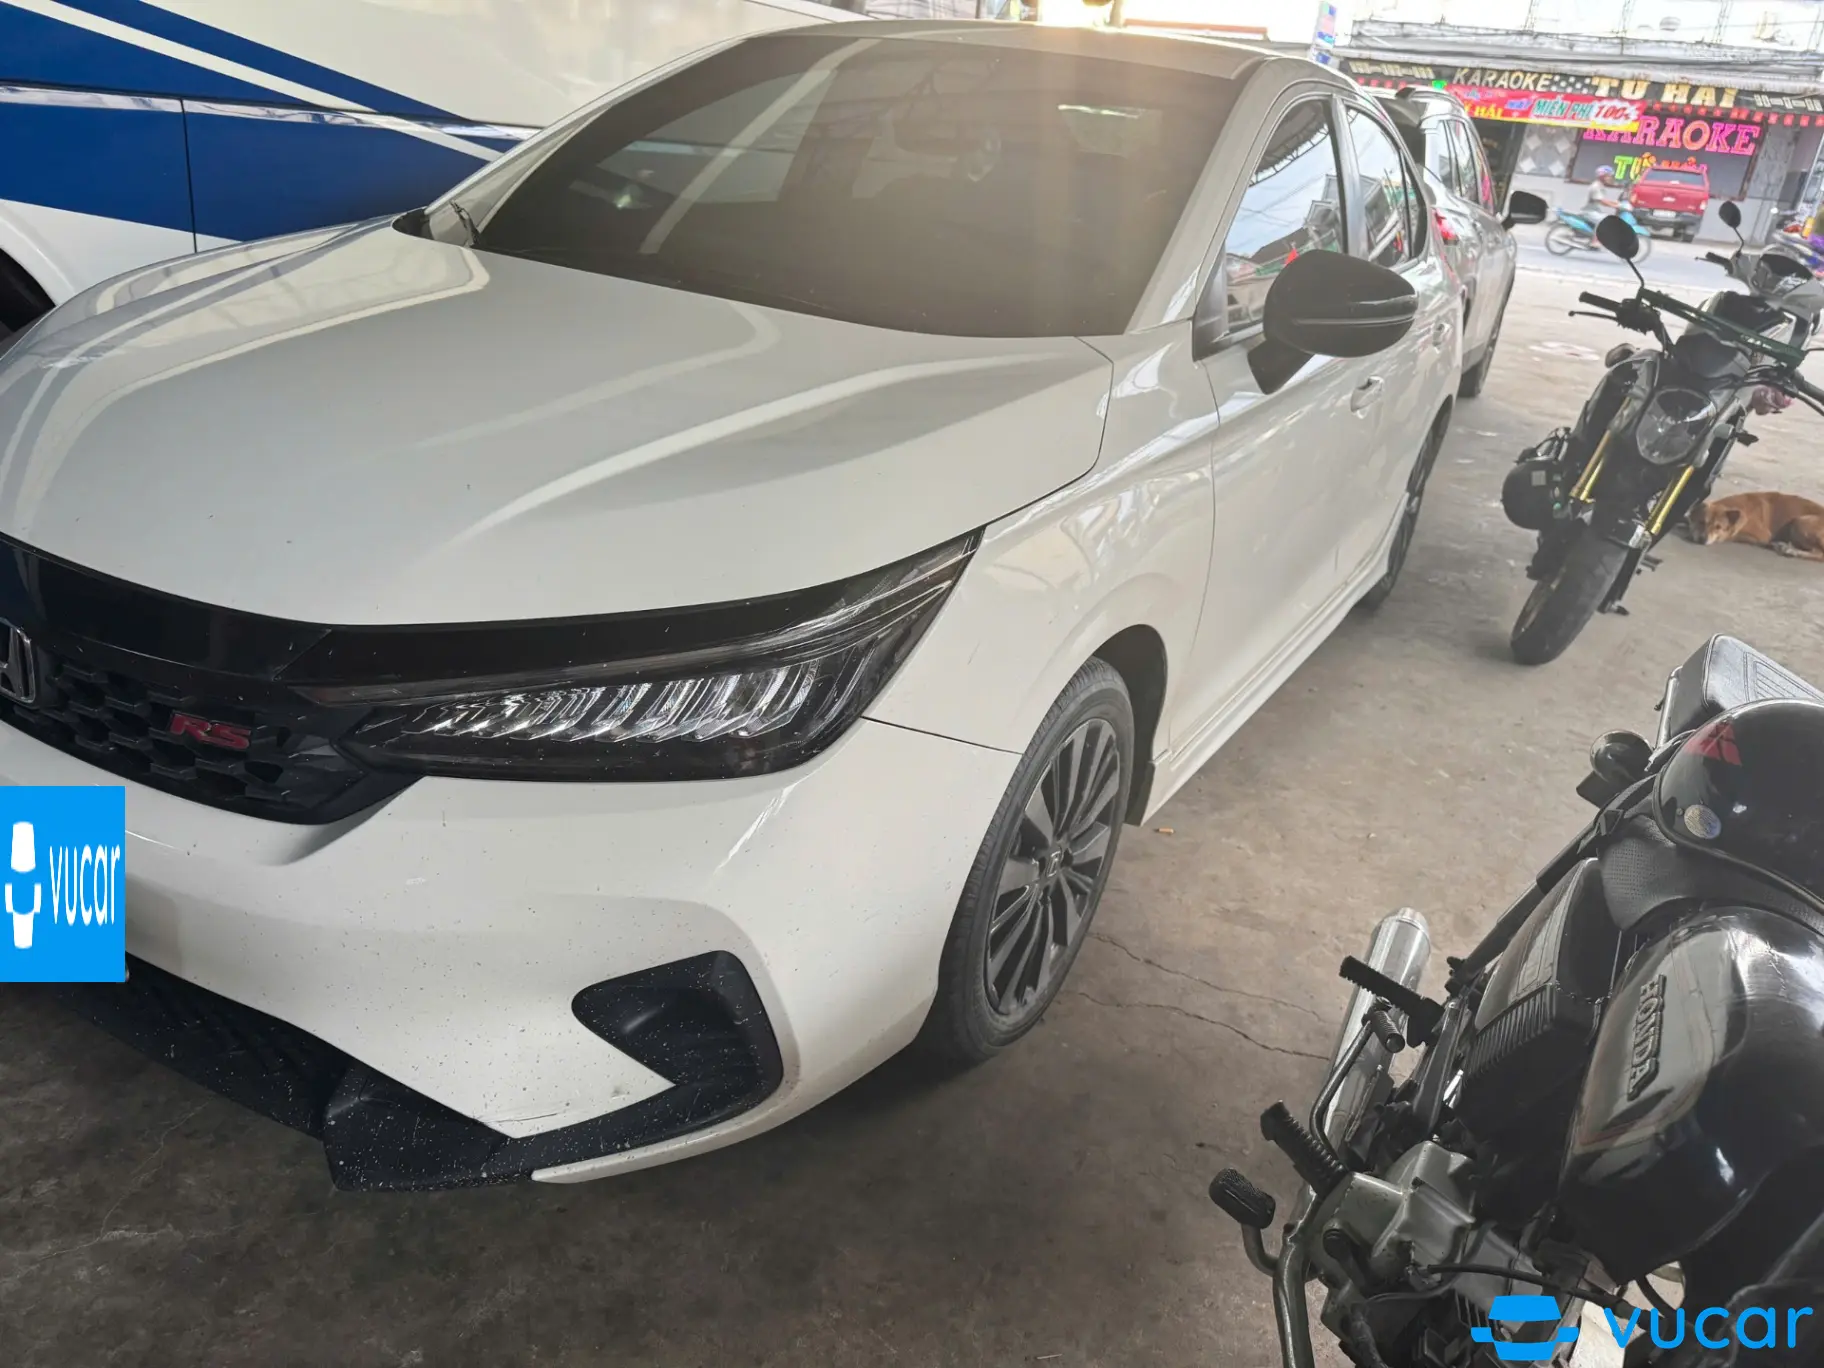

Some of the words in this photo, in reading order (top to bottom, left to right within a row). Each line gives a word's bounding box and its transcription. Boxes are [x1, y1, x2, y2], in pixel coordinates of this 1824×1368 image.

[1453, 67, 1553, 92] KARAOKE
[171, 711, 251, 750] RS
[1627, 974, 1667, 1101] HONDA
